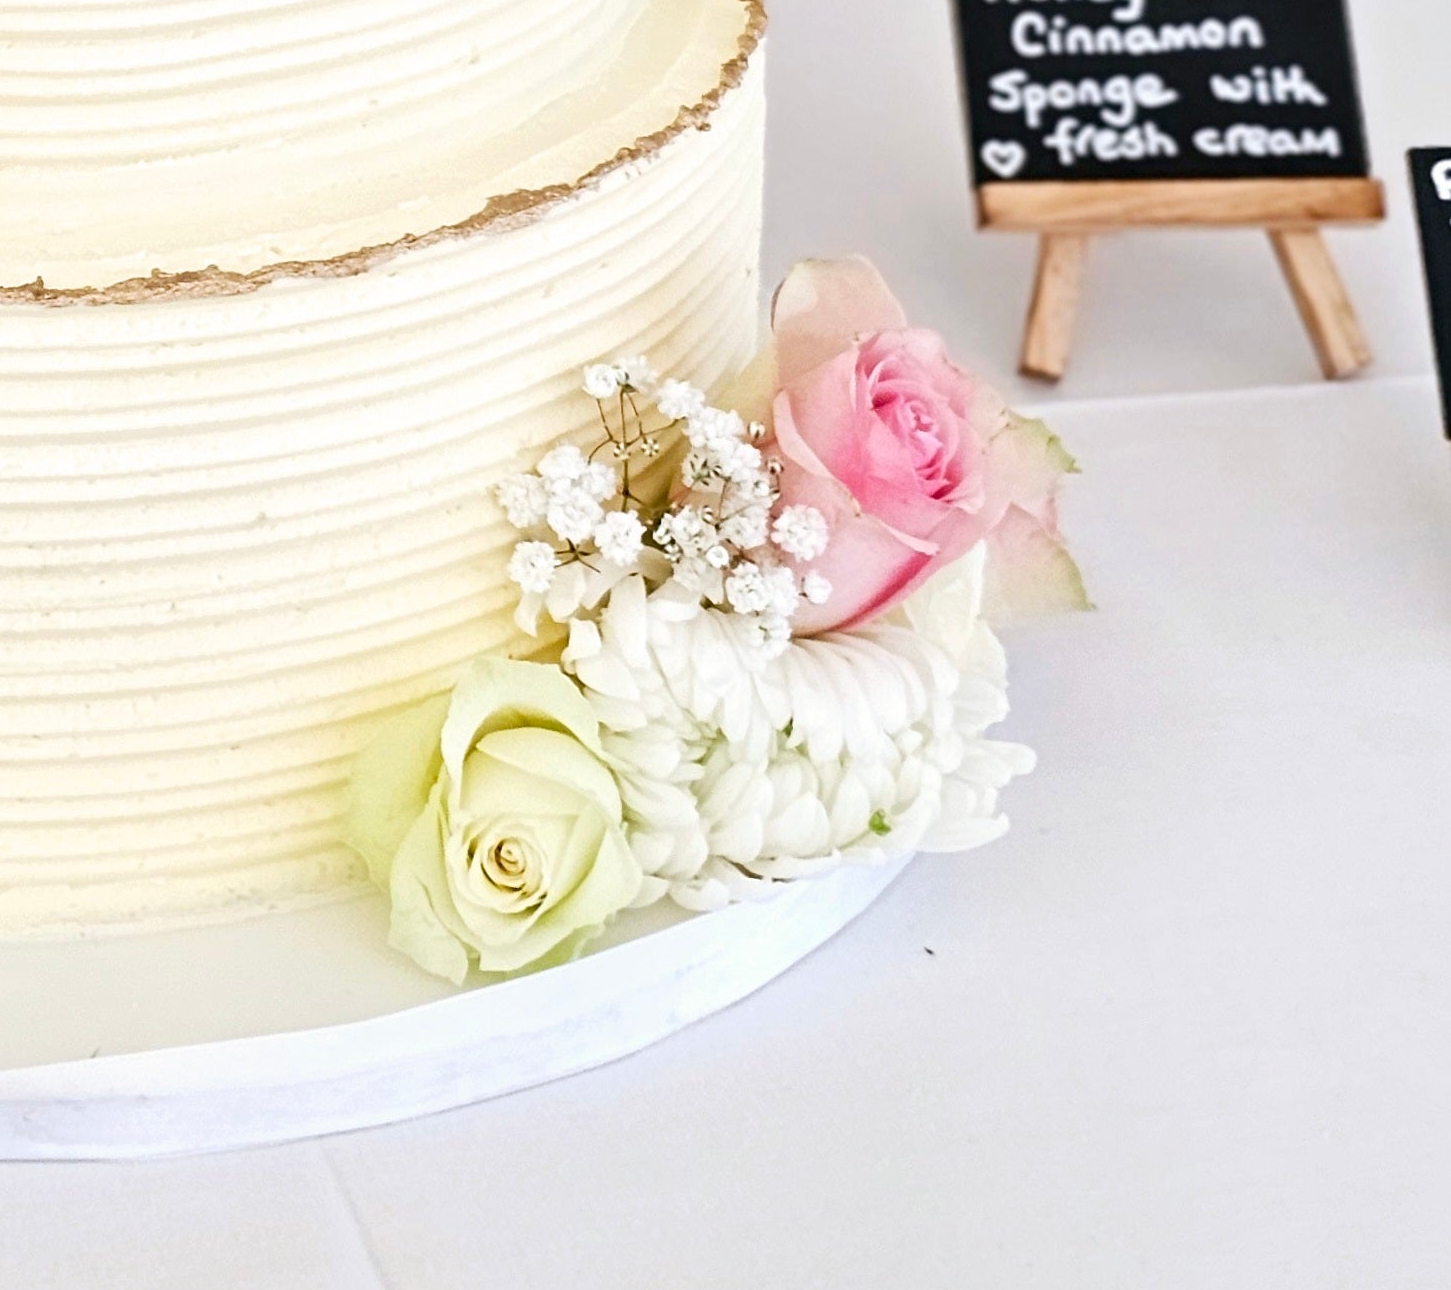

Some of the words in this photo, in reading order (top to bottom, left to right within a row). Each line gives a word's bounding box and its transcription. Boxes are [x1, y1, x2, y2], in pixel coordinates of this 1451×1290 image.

[1010, 11, 1265, 58] Cinnamon
[988, 68, 1179, 128] Sponge
[1209, 64, 1328, 106] with
[1043, 115, 1178, 166] fresh
[1192, 122, 1342, 158] cream
